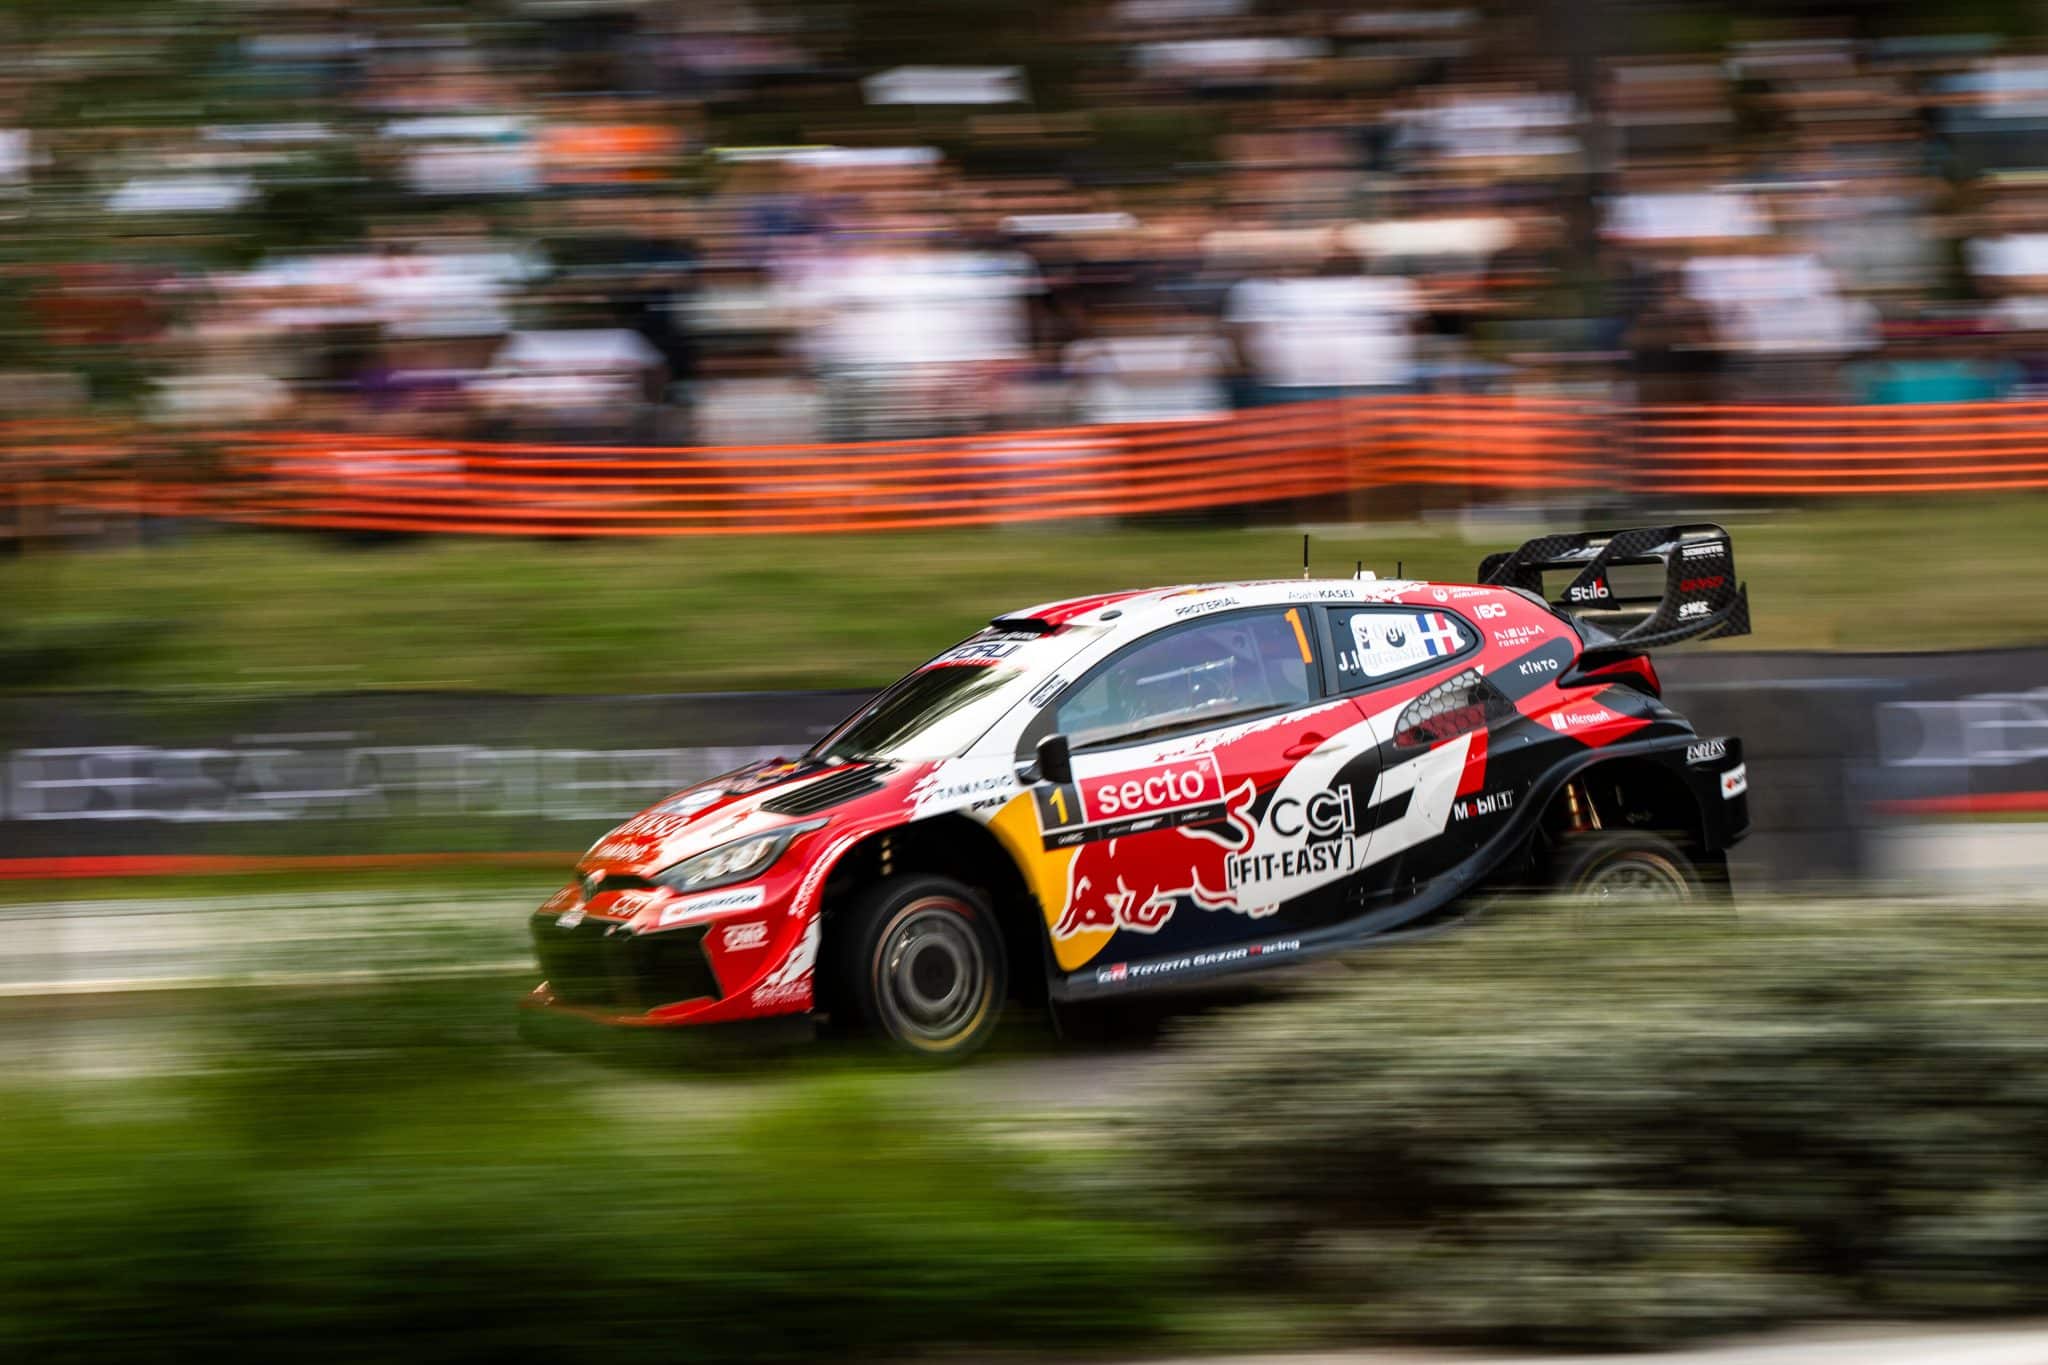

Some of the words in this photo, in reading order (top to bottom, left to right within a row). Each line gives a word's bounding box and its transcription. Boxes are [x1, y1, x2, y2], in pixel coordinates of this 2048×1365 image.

[1570, 580, 1609, 602] Stilo
[1174, 596, 1240, 617] PROTERIAL
[1284, 607, 1313, 664] 1
[1519, 658, 1559, 676] KINTO
[1566, 710, 1611, 726] Microsoft
[1097, 768, 1206, 814] secto
[1049, 786, 1069, 825] 1
[1453, 794, 1497, 821] Mobil
